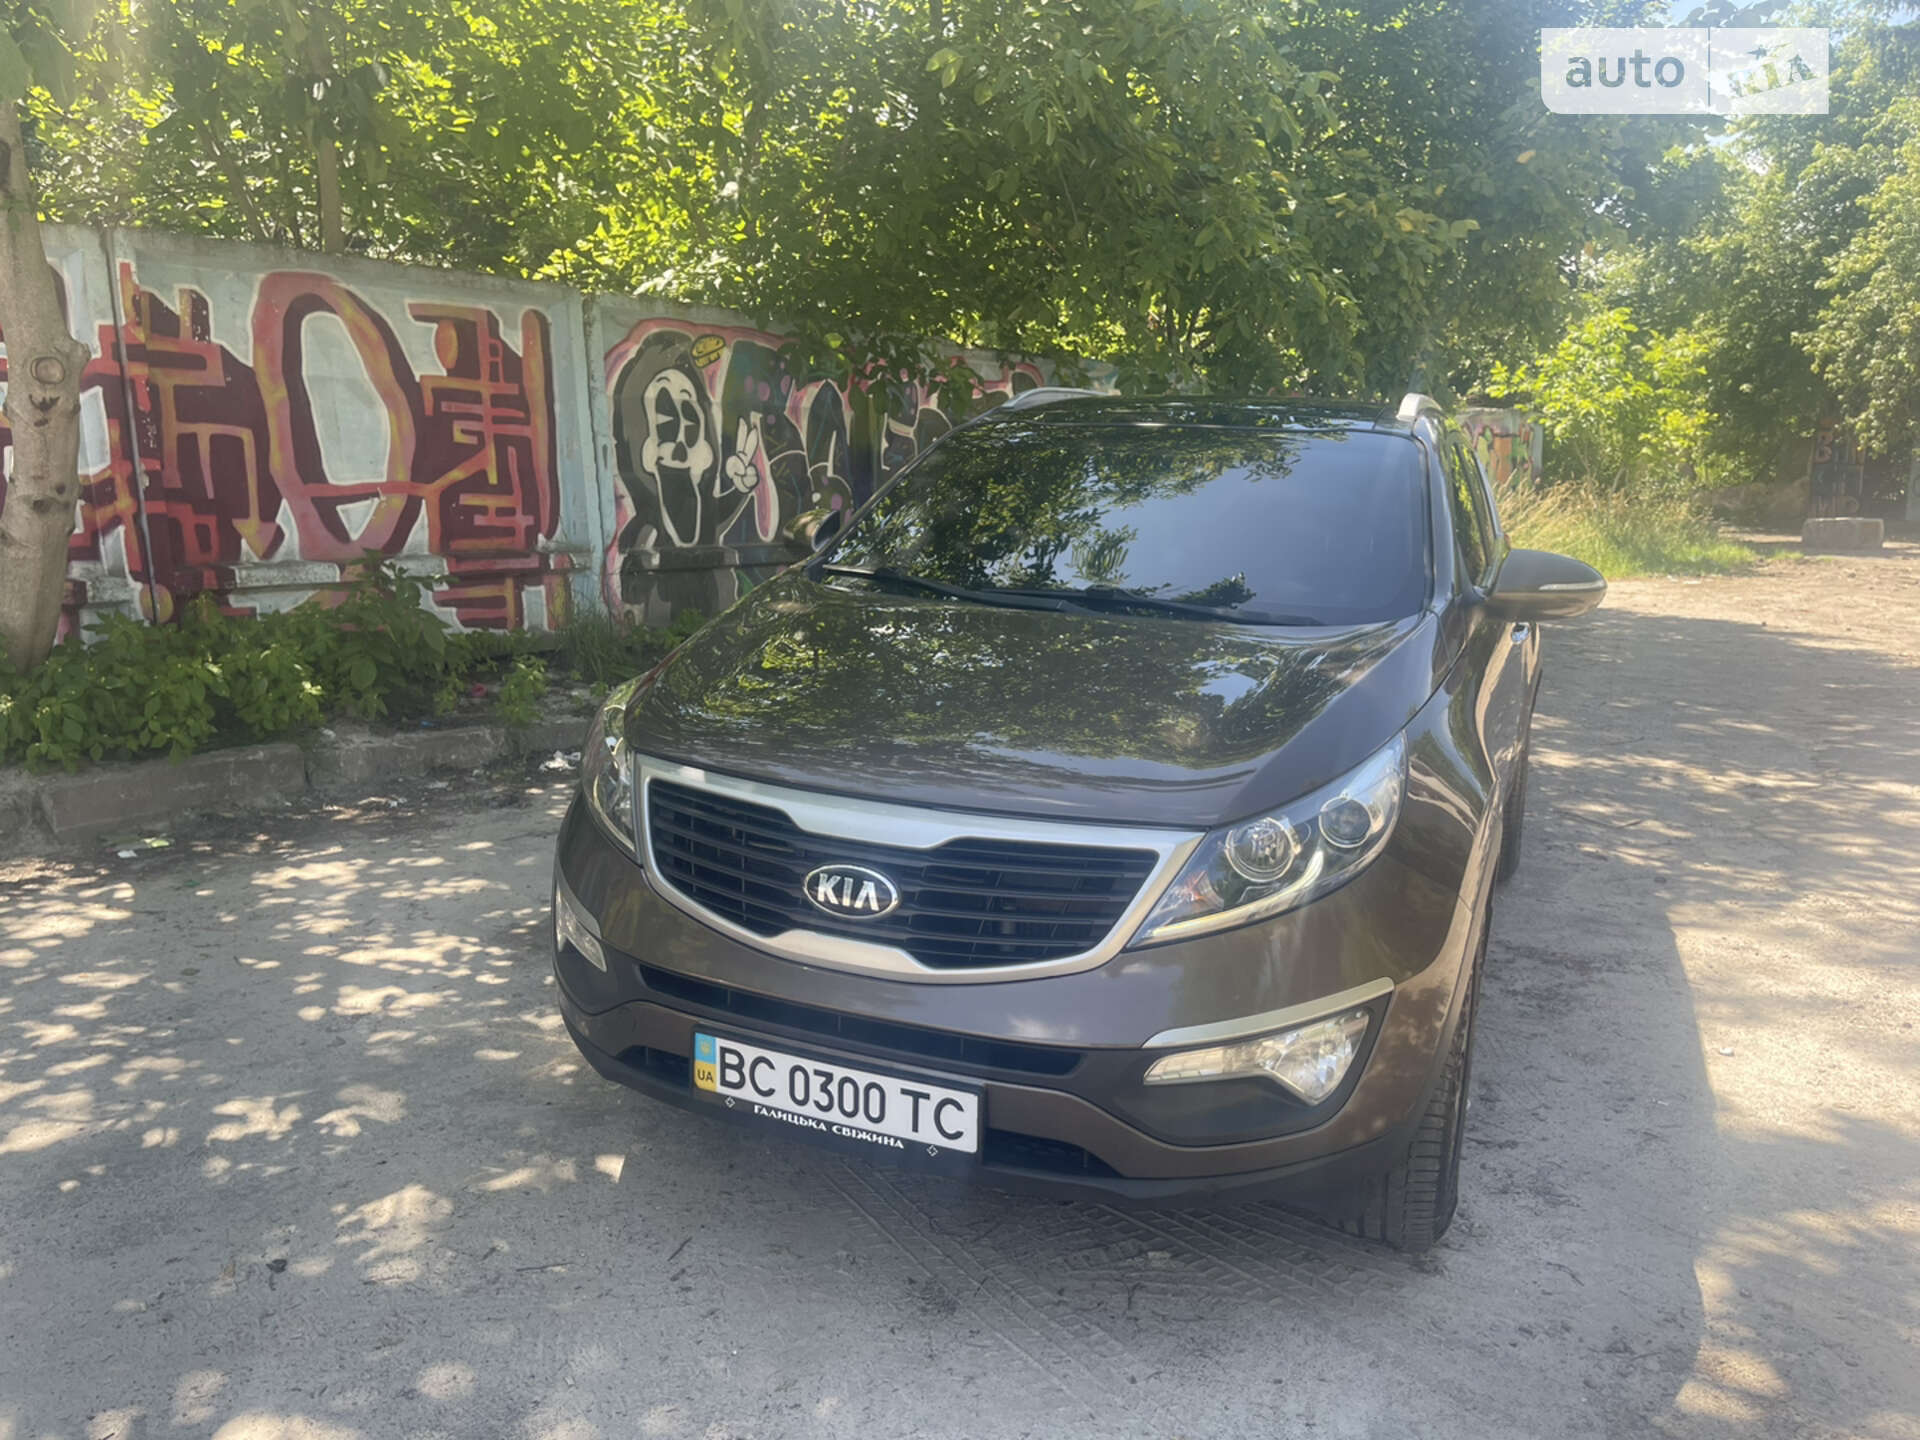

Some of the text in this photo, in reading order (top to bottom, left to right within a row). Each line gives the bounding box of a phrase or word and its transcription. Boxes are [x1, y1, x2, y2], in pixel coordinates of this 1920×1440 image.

[817, 872, 880, 912] KIA
[697, 1068, 714, 1084] UA
[719, 1045, 965, 1141] BC 0300 TC
[753, 1104, 905, 1150] ГАЛИЦЬКА СВІЖИНА
